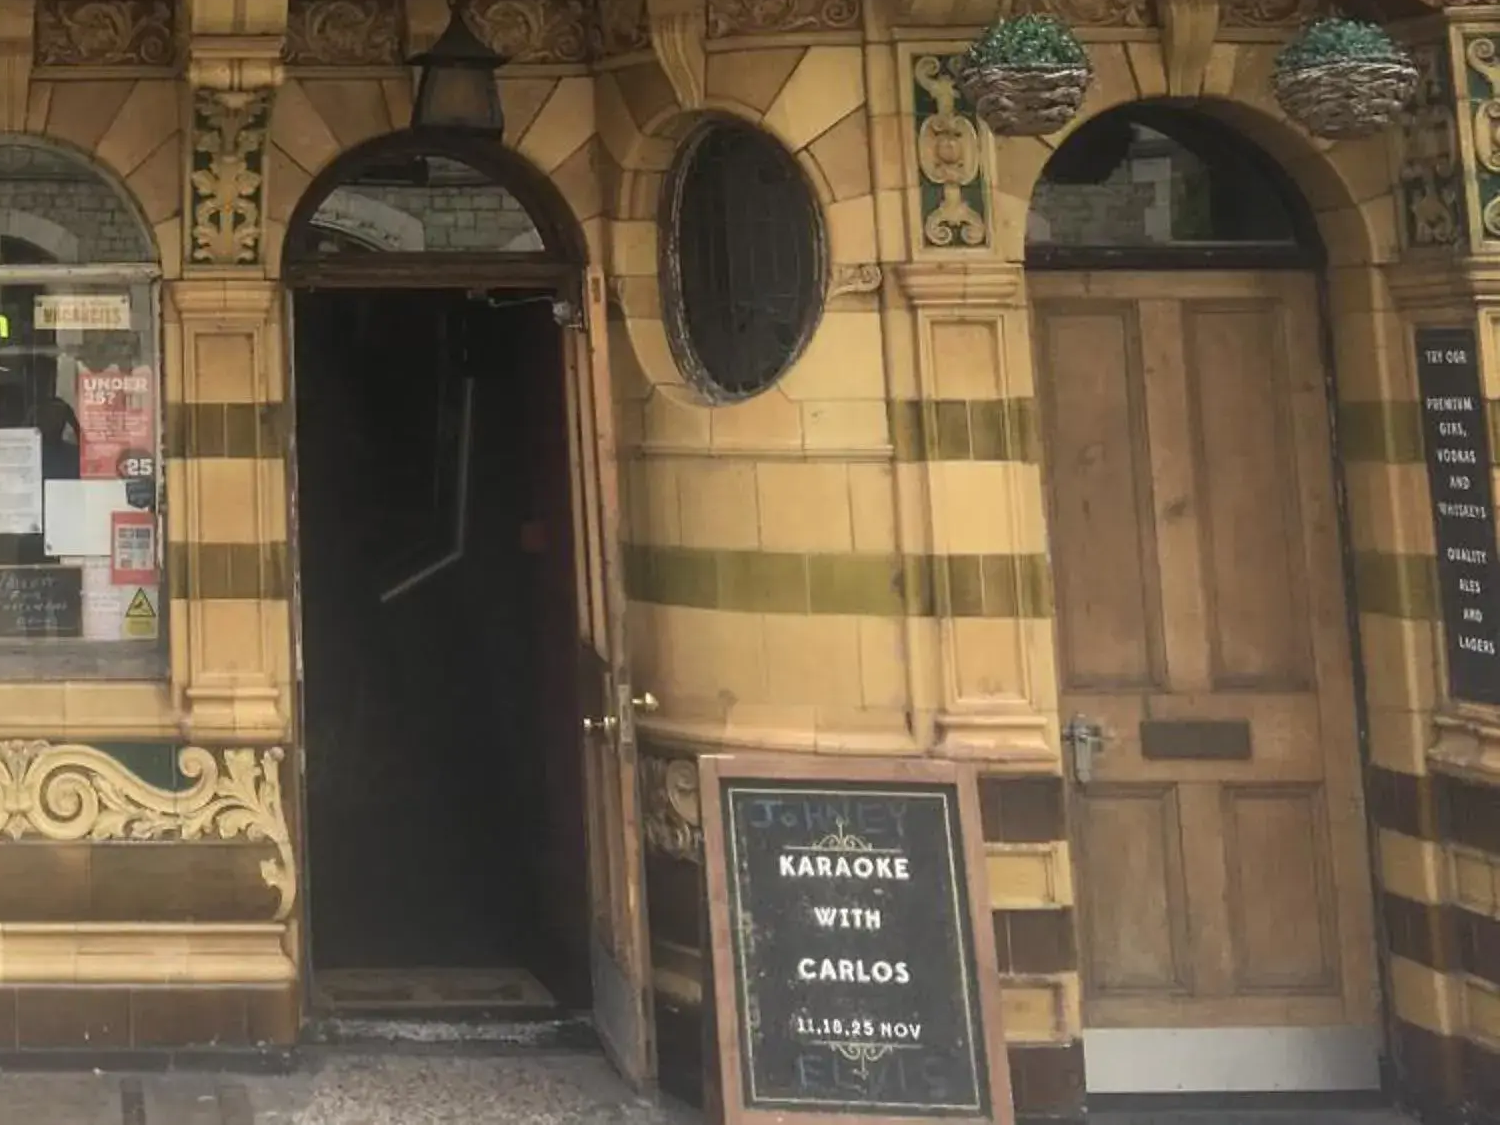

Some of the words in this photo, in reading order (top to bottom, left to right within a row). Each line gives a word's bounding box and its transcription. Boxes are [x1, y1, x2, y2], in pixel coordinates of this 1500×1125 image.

[1426, 397, 1473, 411] PREMIUM
[1437, 449, 1476, 464] VODKAS
[127, 458, 153, 476] 25
[1449, 475, 1471, 490] AND
[1447, 546, 1488, 565] QUALITY
[1463, 607, 1483, 623] AND
[1458, 633, 1495, 655] LAGERS
[780, 854, 910, 880] KARAOKE
[814, 906, 881, 930] WITH
[798, 957, 910, 984] CARLOS
[880, 1021, 921, 1040] NOV
